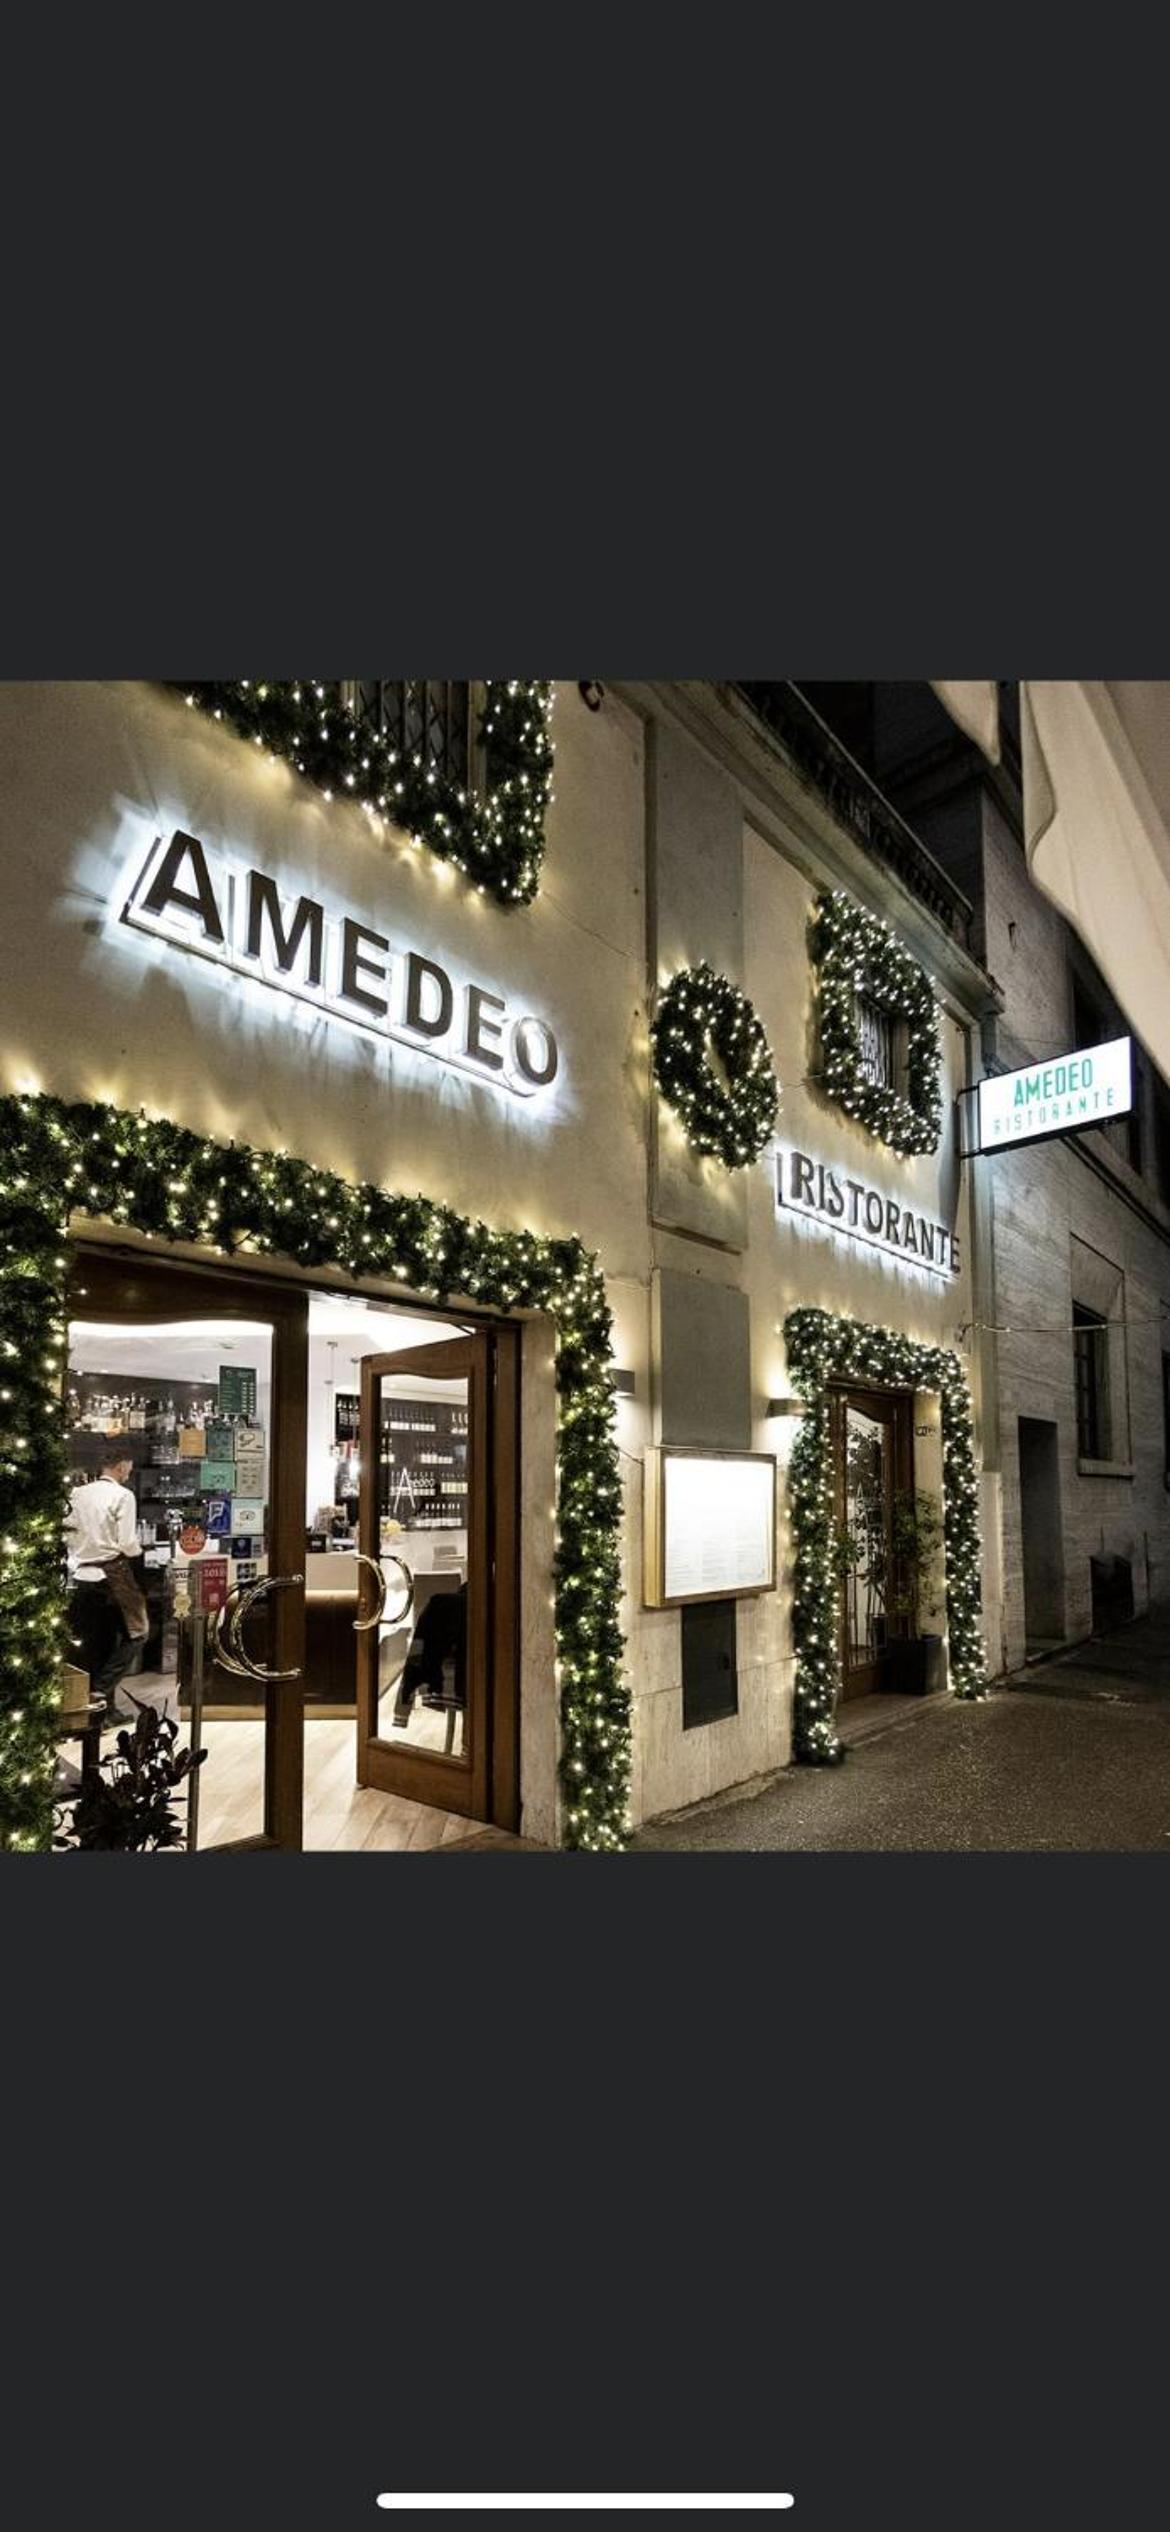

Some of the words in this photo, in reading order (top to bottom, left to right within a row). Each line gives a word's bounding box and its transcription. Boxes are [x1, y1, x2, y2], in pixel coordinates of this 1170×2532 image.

[142, 830, 558, 1085] AMEDEO
[992, 1087, 1114, 1136] RISTORANTE
[1013, 1058, 1093, 1107] AMEDEO
[789, 1151, 960, 1273] RISTORANTE
